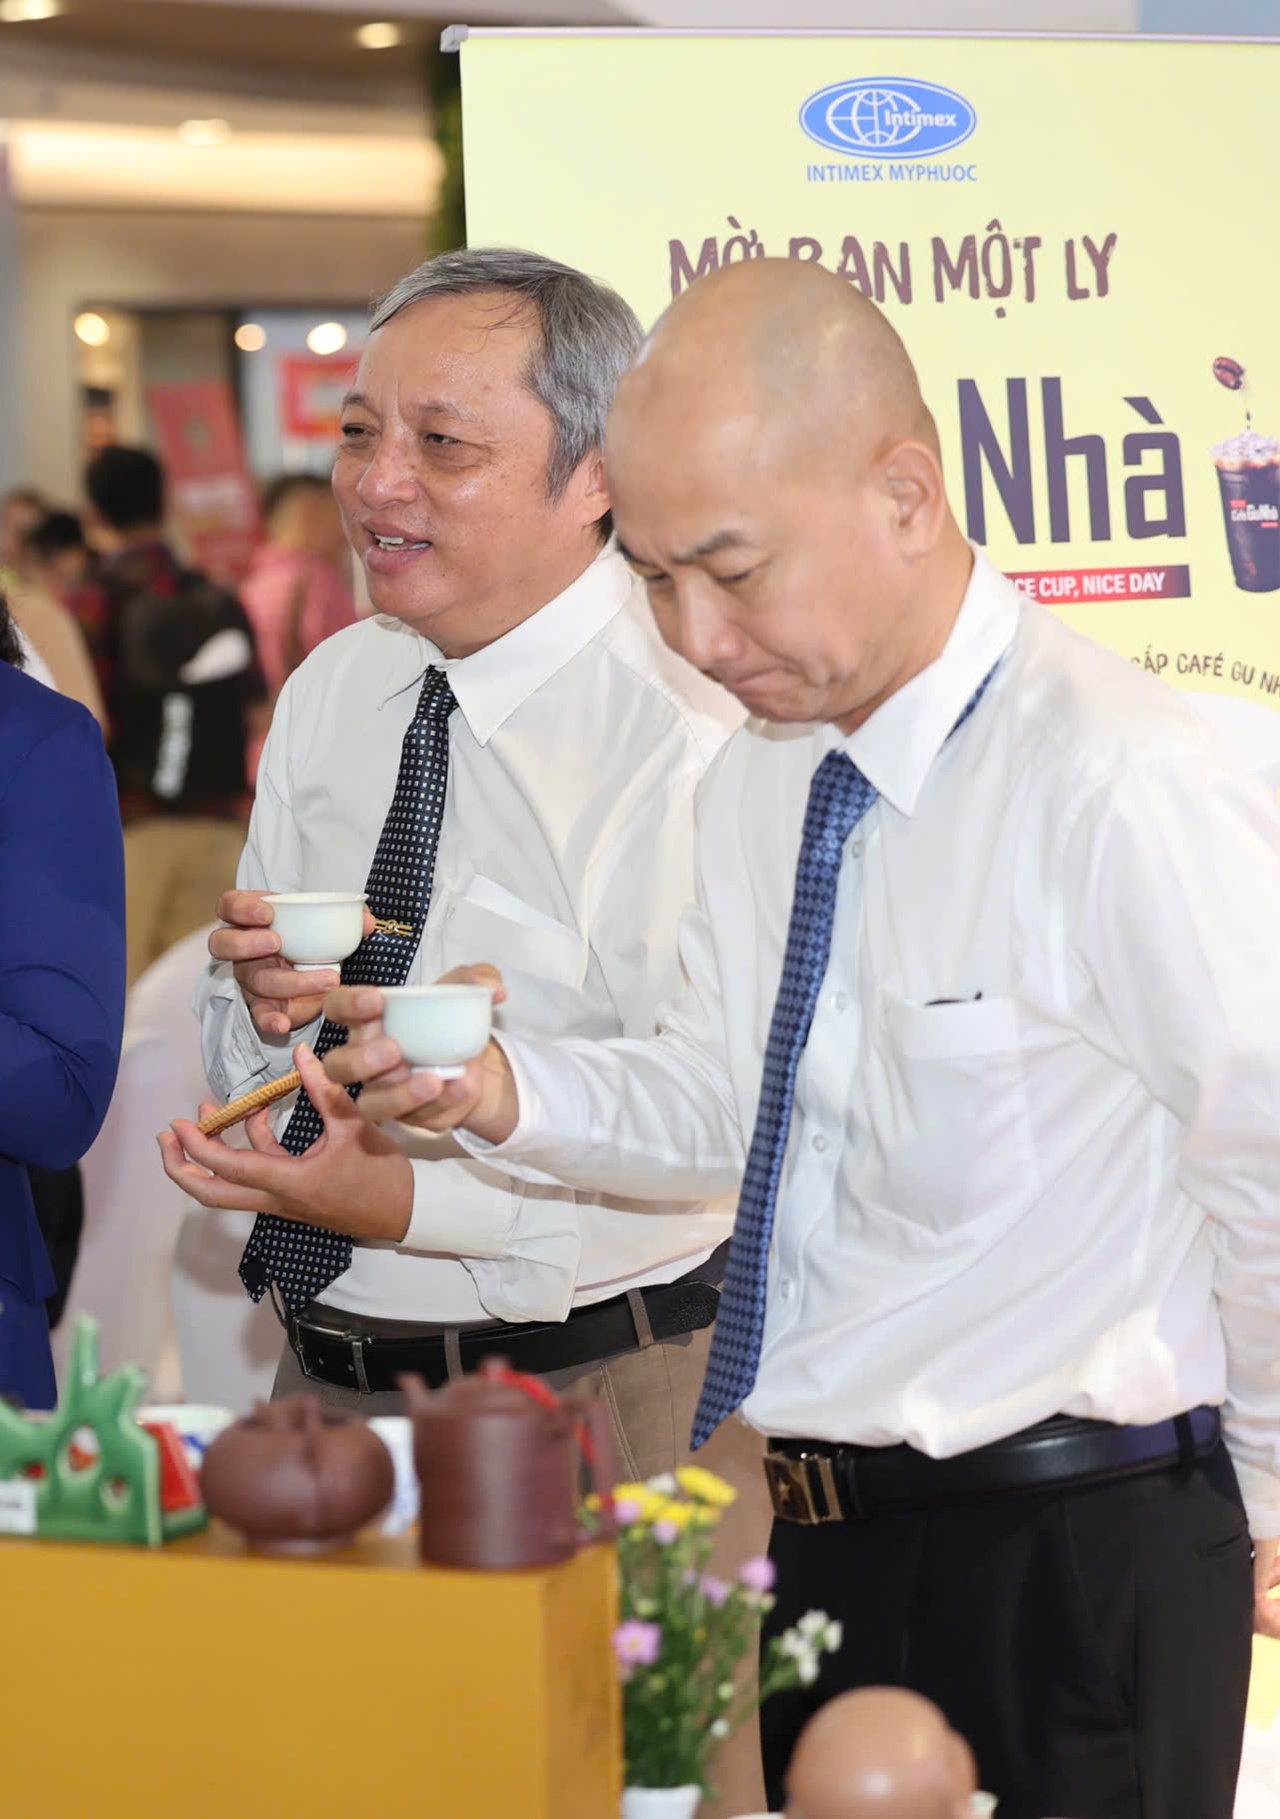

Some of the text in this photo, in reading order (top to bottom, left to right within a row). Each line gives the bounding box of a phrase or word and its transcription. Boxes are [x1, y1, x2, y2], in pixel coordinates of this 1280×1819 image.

[884, 109, 957, 127] Intimex
[806, 164, 978, 182] INTIMEX MYPHUOC
[669, 215, 765, 300] MỜ
[931, 218, 1042, 318] MỘT
[1065, 232, 1117, 300] LY
[957, 376, 1187, 546] Nhà
[1038, 576, 1079, 598] CUP,
[1082, 573, 1126, 595] NICE
[1129, 571, 1165, 593] DAY
[1176, 652, 1224, 677] CAFÉ
[1231, 661, 1255, 685] GU
